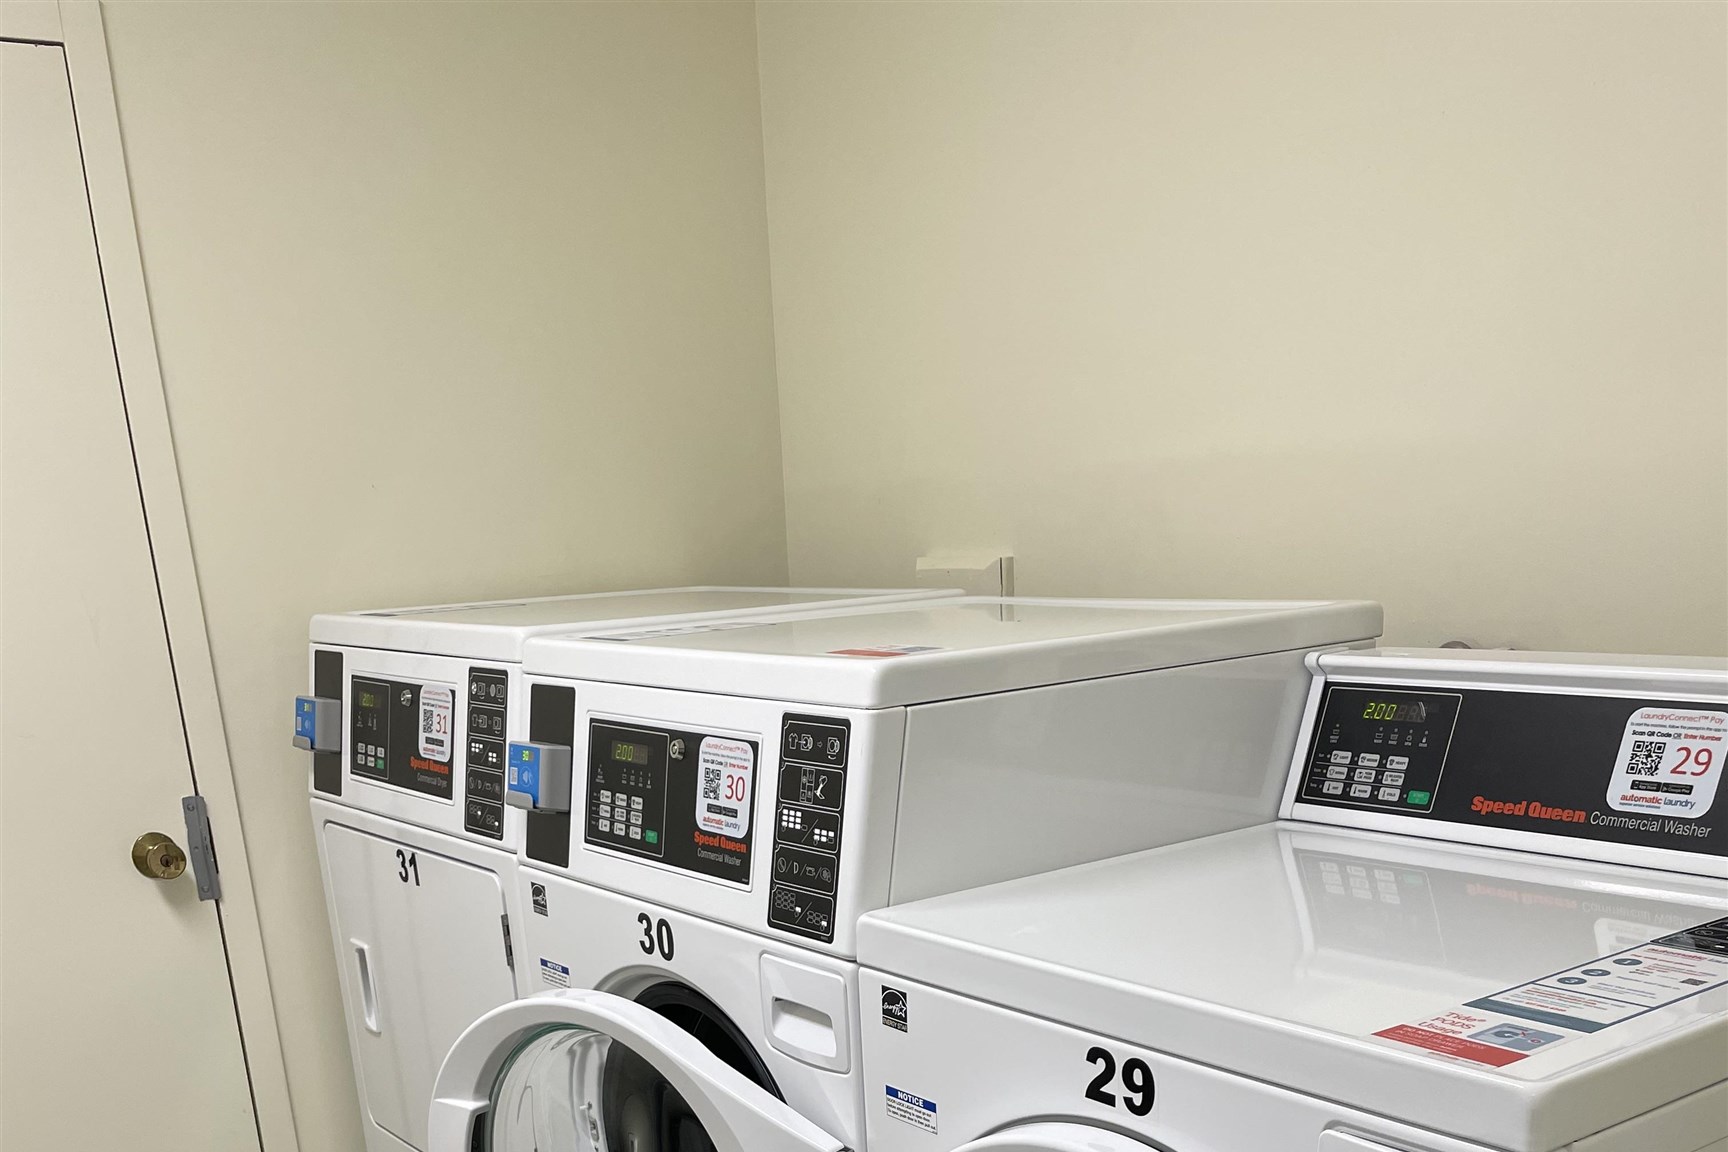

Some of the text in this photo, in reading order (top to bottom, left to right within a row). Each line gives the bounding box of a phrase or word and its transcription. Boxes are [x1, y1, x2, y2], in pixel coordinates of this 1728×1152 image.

[1363, 702, 1398, 720] 2.00
[1710, 715, 1725, 725] Pay
[436, 713, 448, 734] 31
[1647, 730, 1656, 738] QR
[1656, 731, 1672, 739] Code
[1684, 733, 1698, 741] Enter
[1699, 734, 1723, 742] Number
[1669, 746, 1713, 777] 29
[725, 774, 745, 802] 30
[1620, 794, 1697, 811] automatic laundry
[1471, 795, 1712, 838] Speed Queen Commercial Washer
[694, 831, 747, 854] Speed Queen
[396, 848, 421, 887] 31
[637, 912, 675, 962] 30
[1084, 1046, 1156, 1117] 29
[897, 1090, 924, 1108] NOTICE
